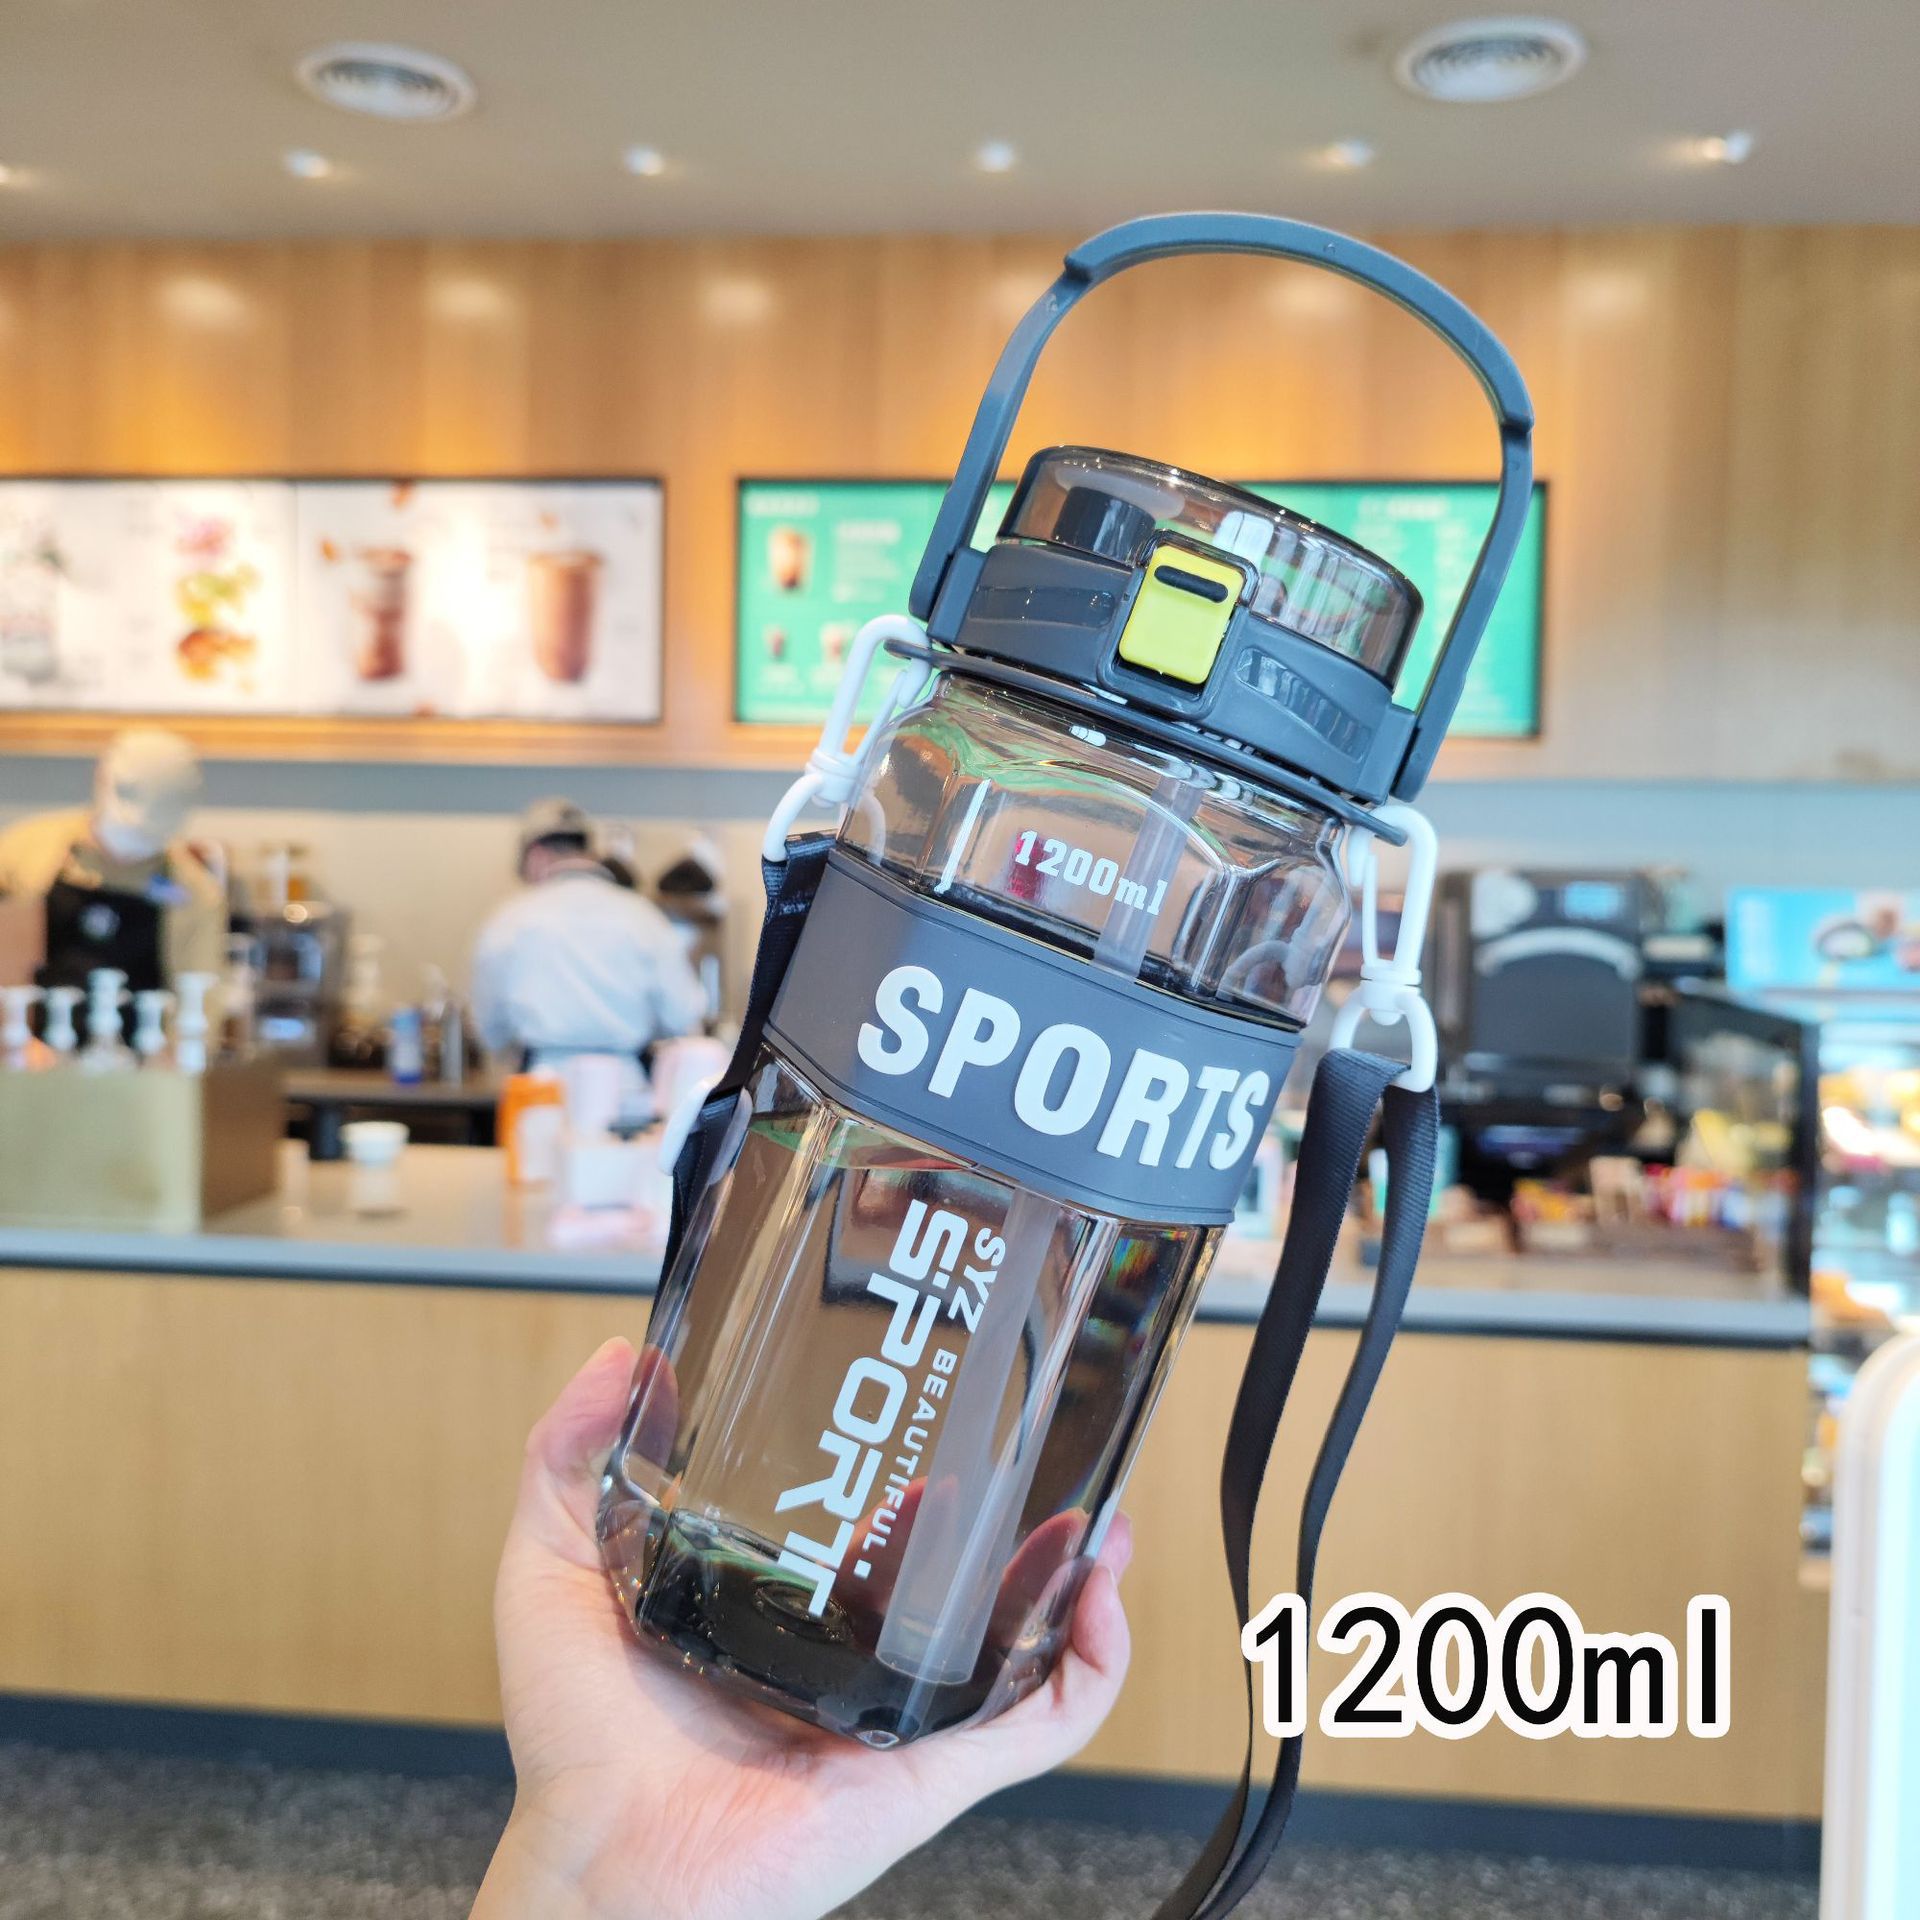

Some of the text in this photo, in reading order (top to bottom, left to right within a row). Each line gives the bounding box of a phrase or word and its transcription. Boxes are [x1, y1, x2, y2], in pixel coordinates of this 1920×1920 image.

[1015, 830, 1168, 916] 1200ml
[857, 965, 1270, 1171] SPORTS
[948, 1227, 1006, 1334] SYZ
[774, 1198, 968, 1618] SPORT
